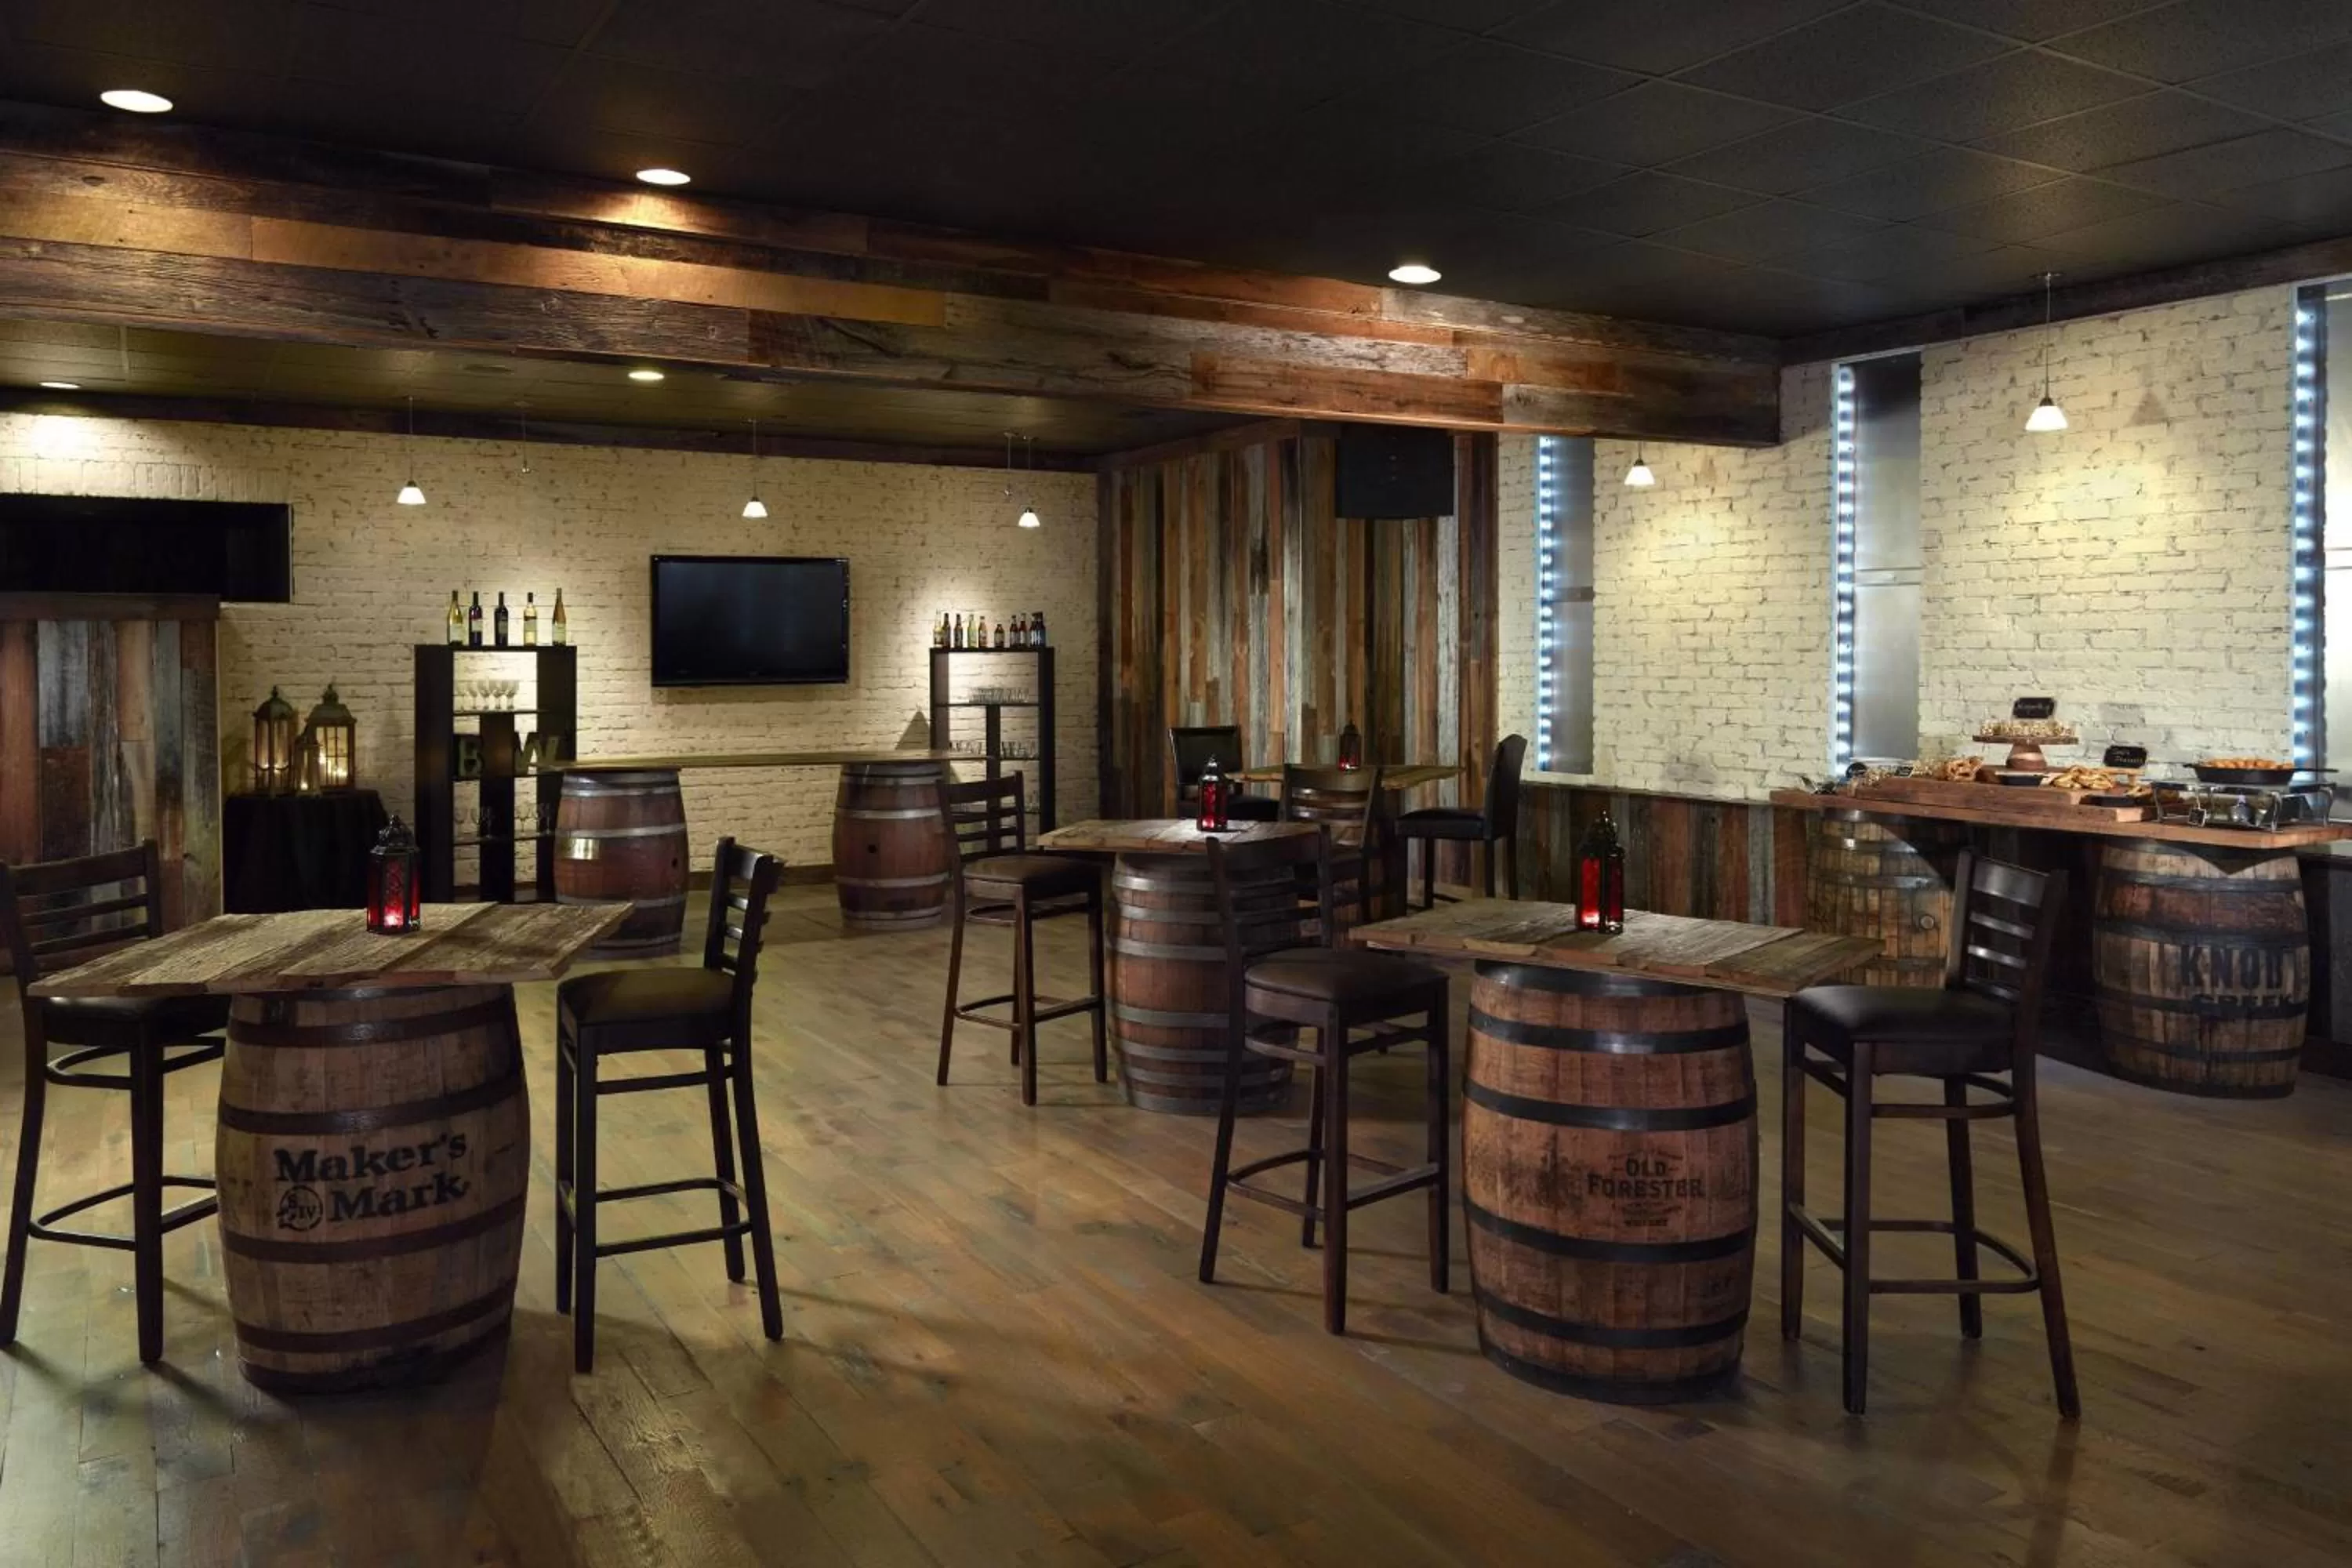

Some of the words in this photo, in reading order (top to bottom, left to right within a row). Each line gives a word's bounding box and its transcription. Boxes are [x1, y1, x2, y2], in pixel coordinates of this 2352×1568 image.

[274, 1133, 466, 1181] Maker's
[1626, 1157, 1667, 1177] OLD
[328, 1171, 470, 1222] Mark
[1587, 1173, 1704, 1198] FORESTER
